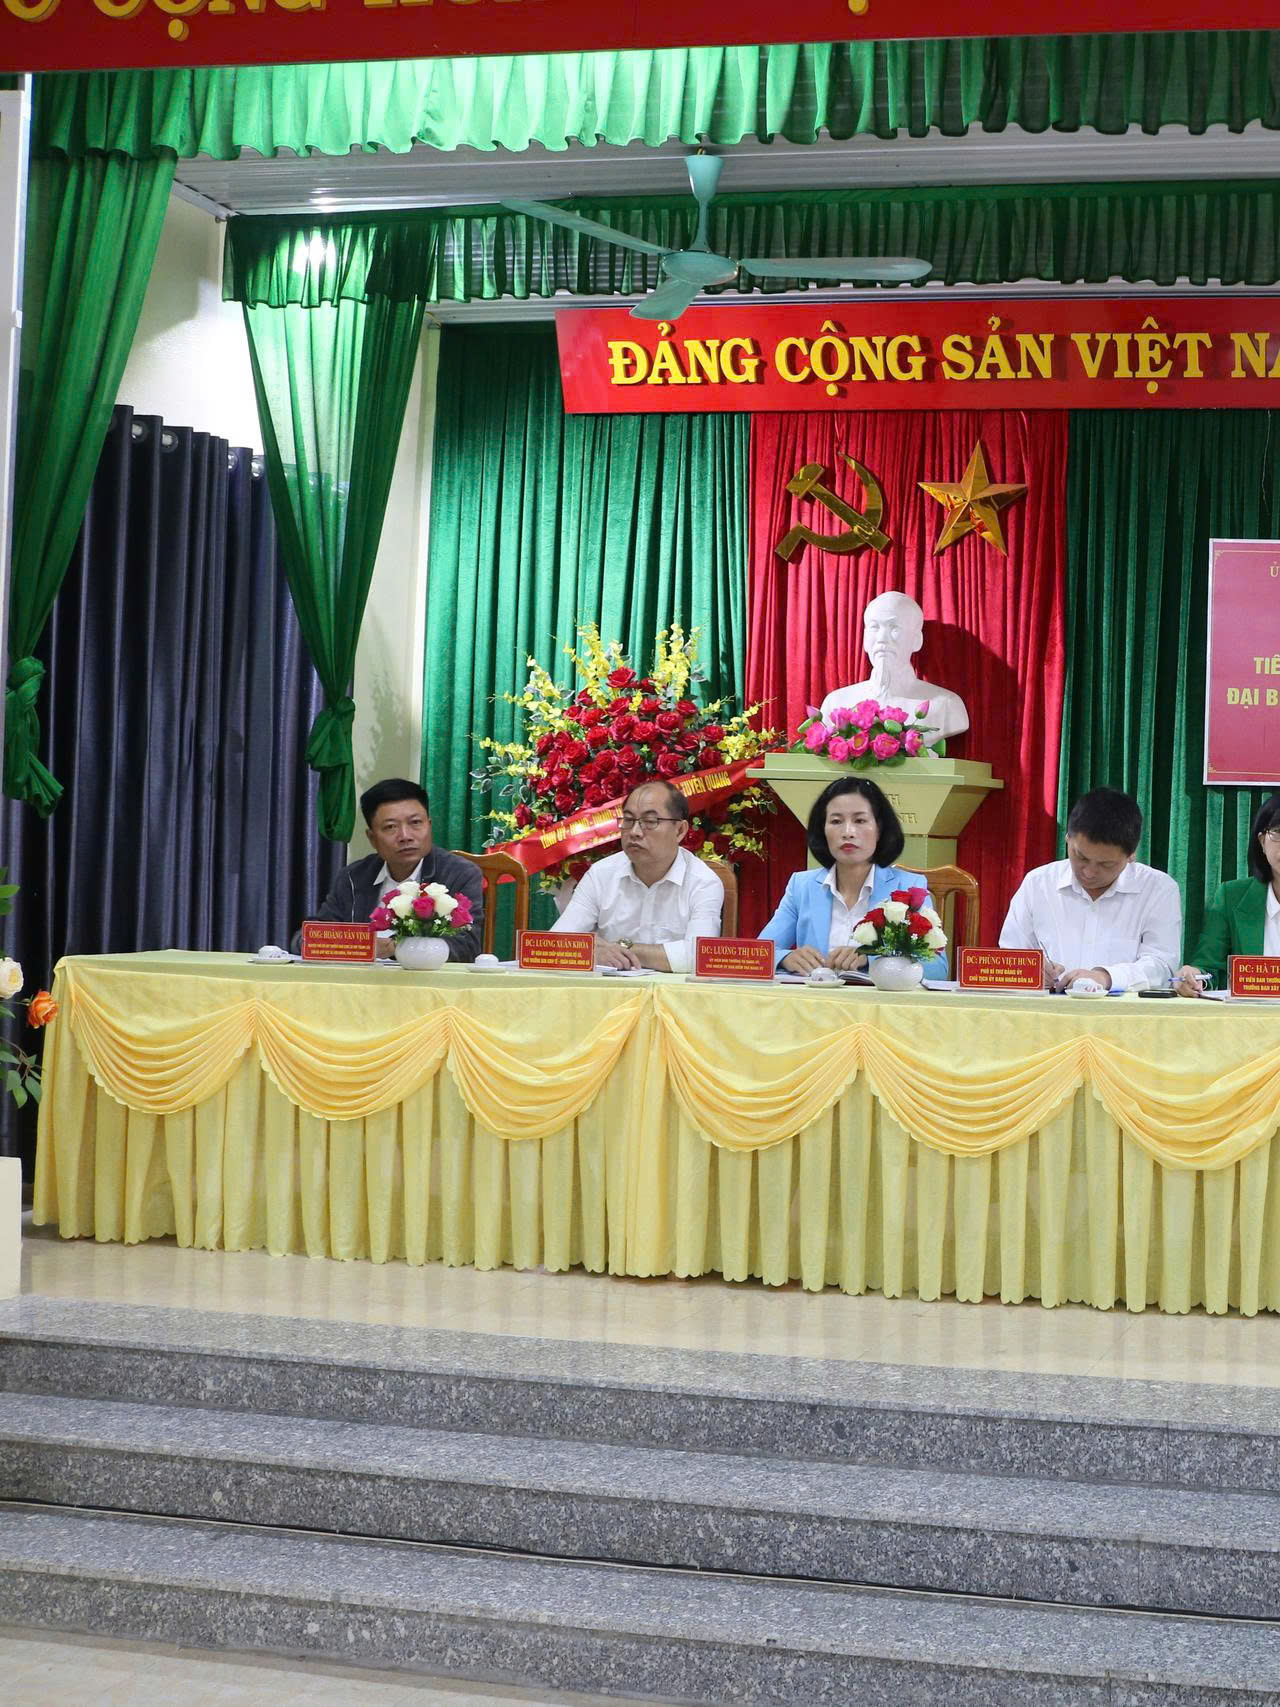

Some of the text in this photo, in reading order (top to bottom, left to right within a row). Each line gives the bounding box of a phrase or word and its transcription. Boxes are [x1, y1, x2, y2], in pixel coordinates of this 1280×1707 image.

[608, 321, 760, 386] ĐẢNG
[774, 320, 927, 397] CỘNG
[941, 316, 1054, 380] SẢN
[1071, 316, 1213, 394] VIỆT
[1227, 687, 1259, 709] ĐẠI
[704, 770, 732, 792] QUANG
[1239, 964, 1254, 973] ĐC:
[1256, 962, 1268, 973] HÀ
